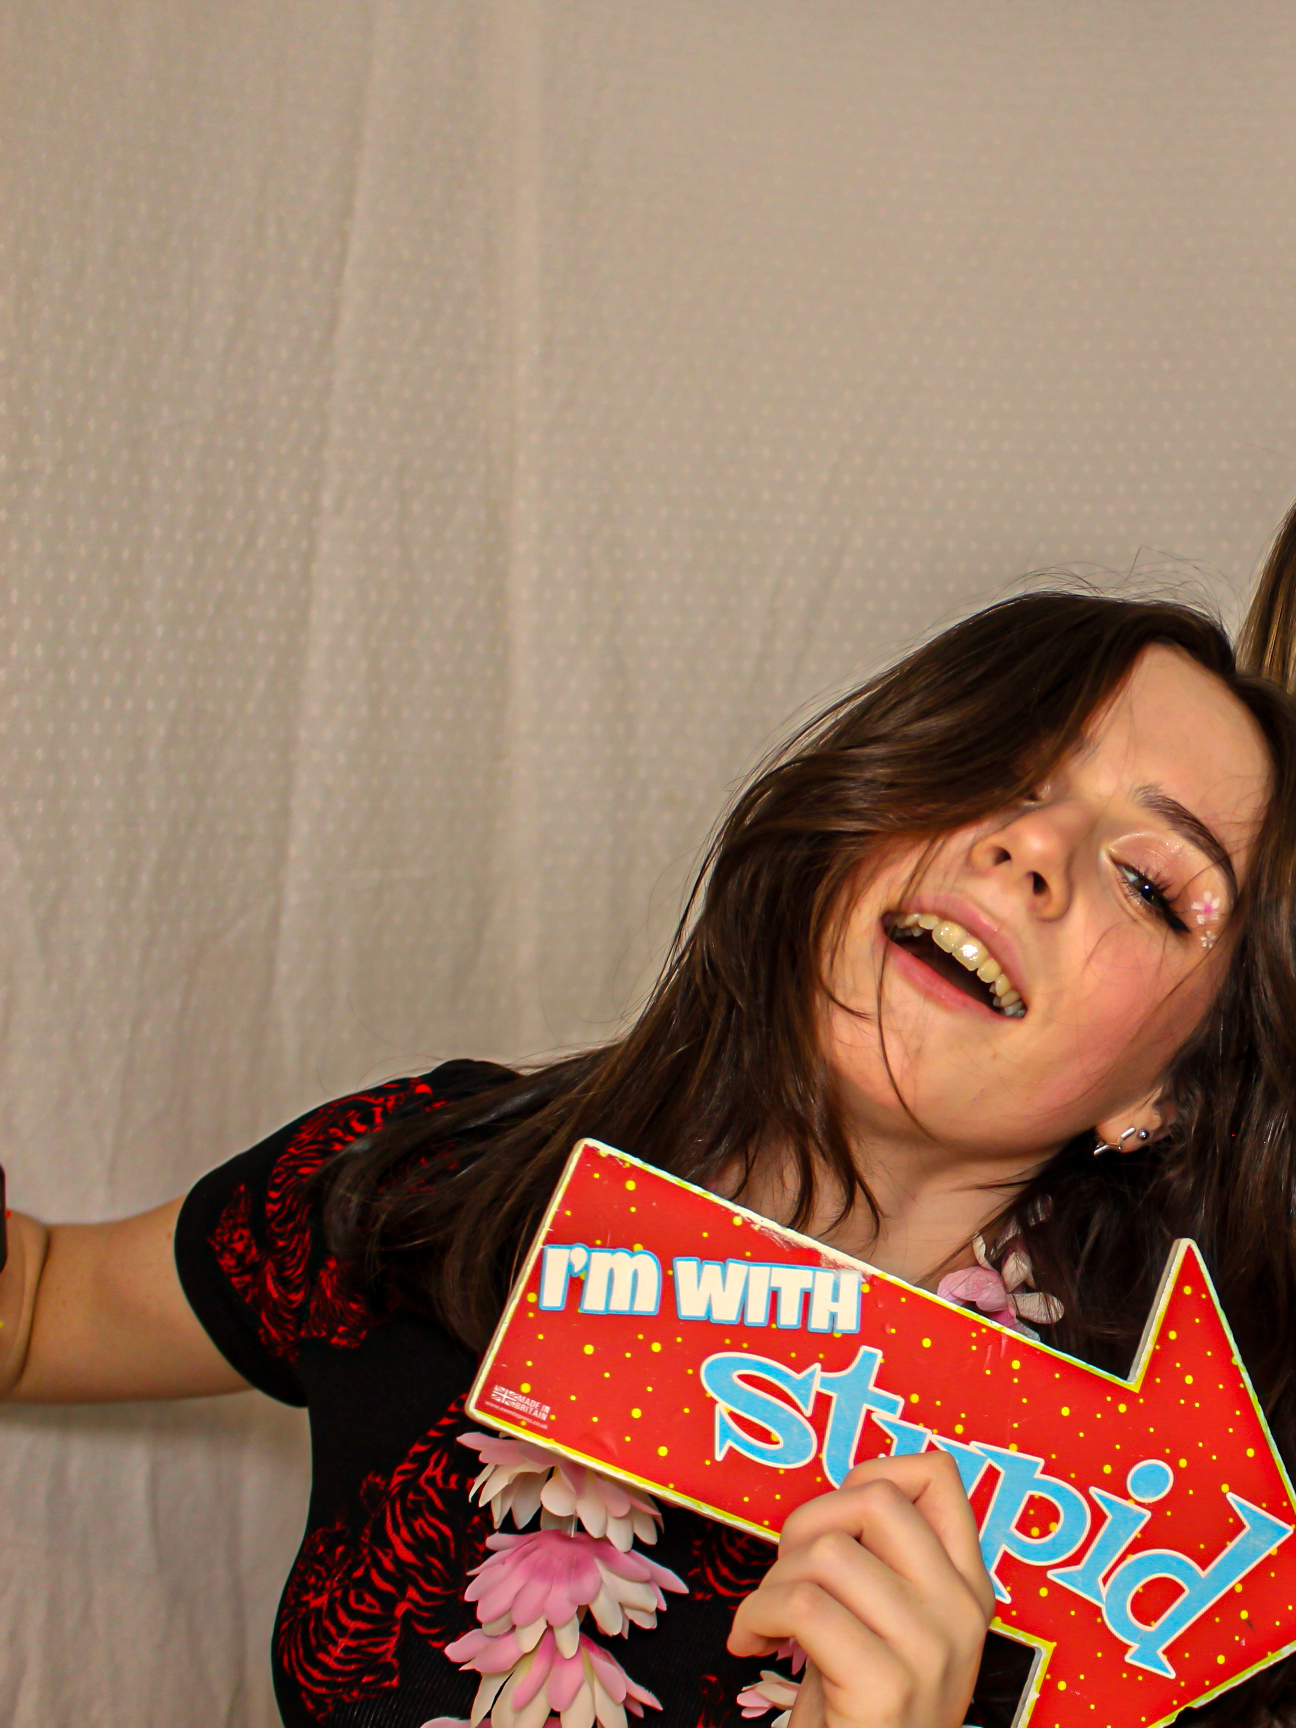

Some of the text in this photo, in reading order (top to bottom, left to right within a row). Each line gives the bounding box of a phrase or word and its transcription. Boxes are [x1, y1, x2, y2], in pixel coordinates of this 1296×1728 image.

[672, 1256, 865, 1334] WITH
[514, 1402, 549, 1421] BRITAIN
[517, 1394, 551, 1414] MADE IN
